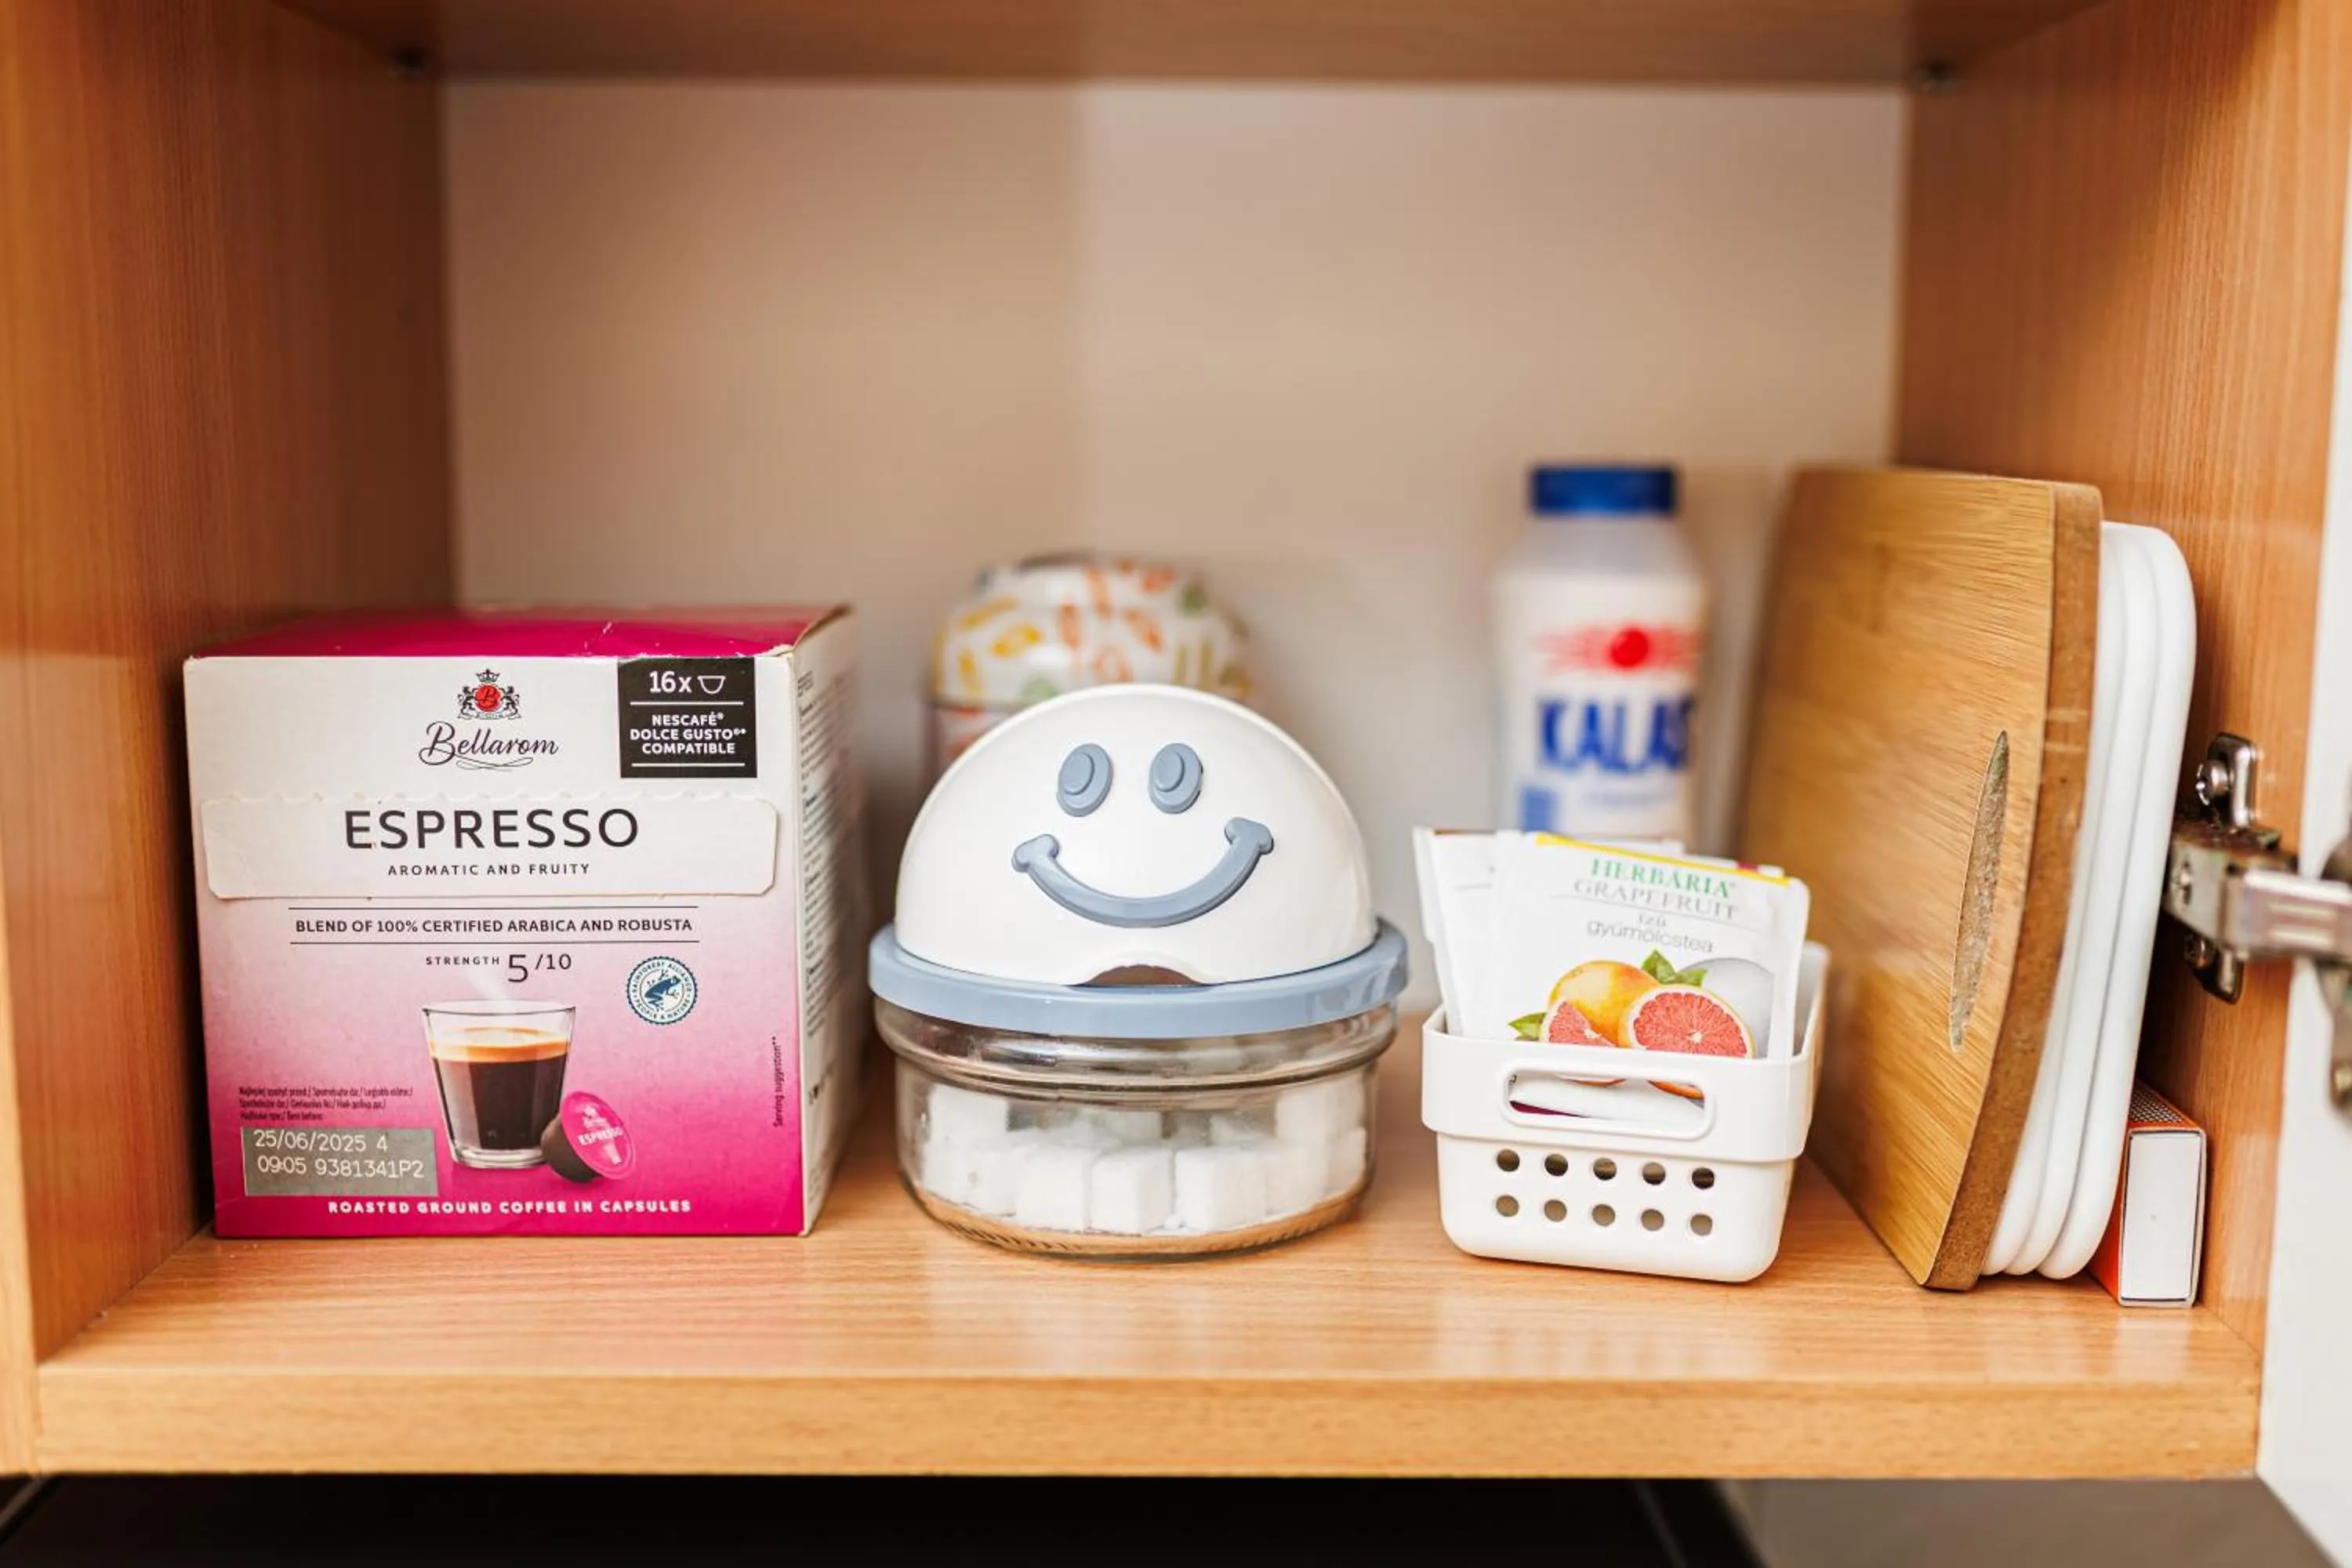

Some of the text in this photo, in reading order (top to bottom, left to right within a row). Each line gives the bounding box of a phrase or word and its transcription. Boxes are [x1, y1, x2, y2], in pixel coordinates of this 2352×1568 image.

[649, 670, 692, 693] 16x
[630, 728, 679, 741] DOLCE
[419, 720, 559, 771] Bellarom
[641, 742, 735, 754] COMPATIBLE
[344, 808, 639, 850] ESPRESSO
[387, 862, 590, 877] AROMATIC AND FRUITY
[1573, 877, 1740, 920] GRAPEFRUIT
[296, 918, 693, 933] BLEND OF 100% CERTIFIED ARABICA AND ROBUSTA
[425, 956, 499, 966] STRENGTH
[252, 1128, 389, 1152] 25/06/2025 4
[314, 1158, 425, 1178] 9381341P2
[328, 1200, 691, 1214] ROASTED GROUND COFFEE IN CAPSULES
